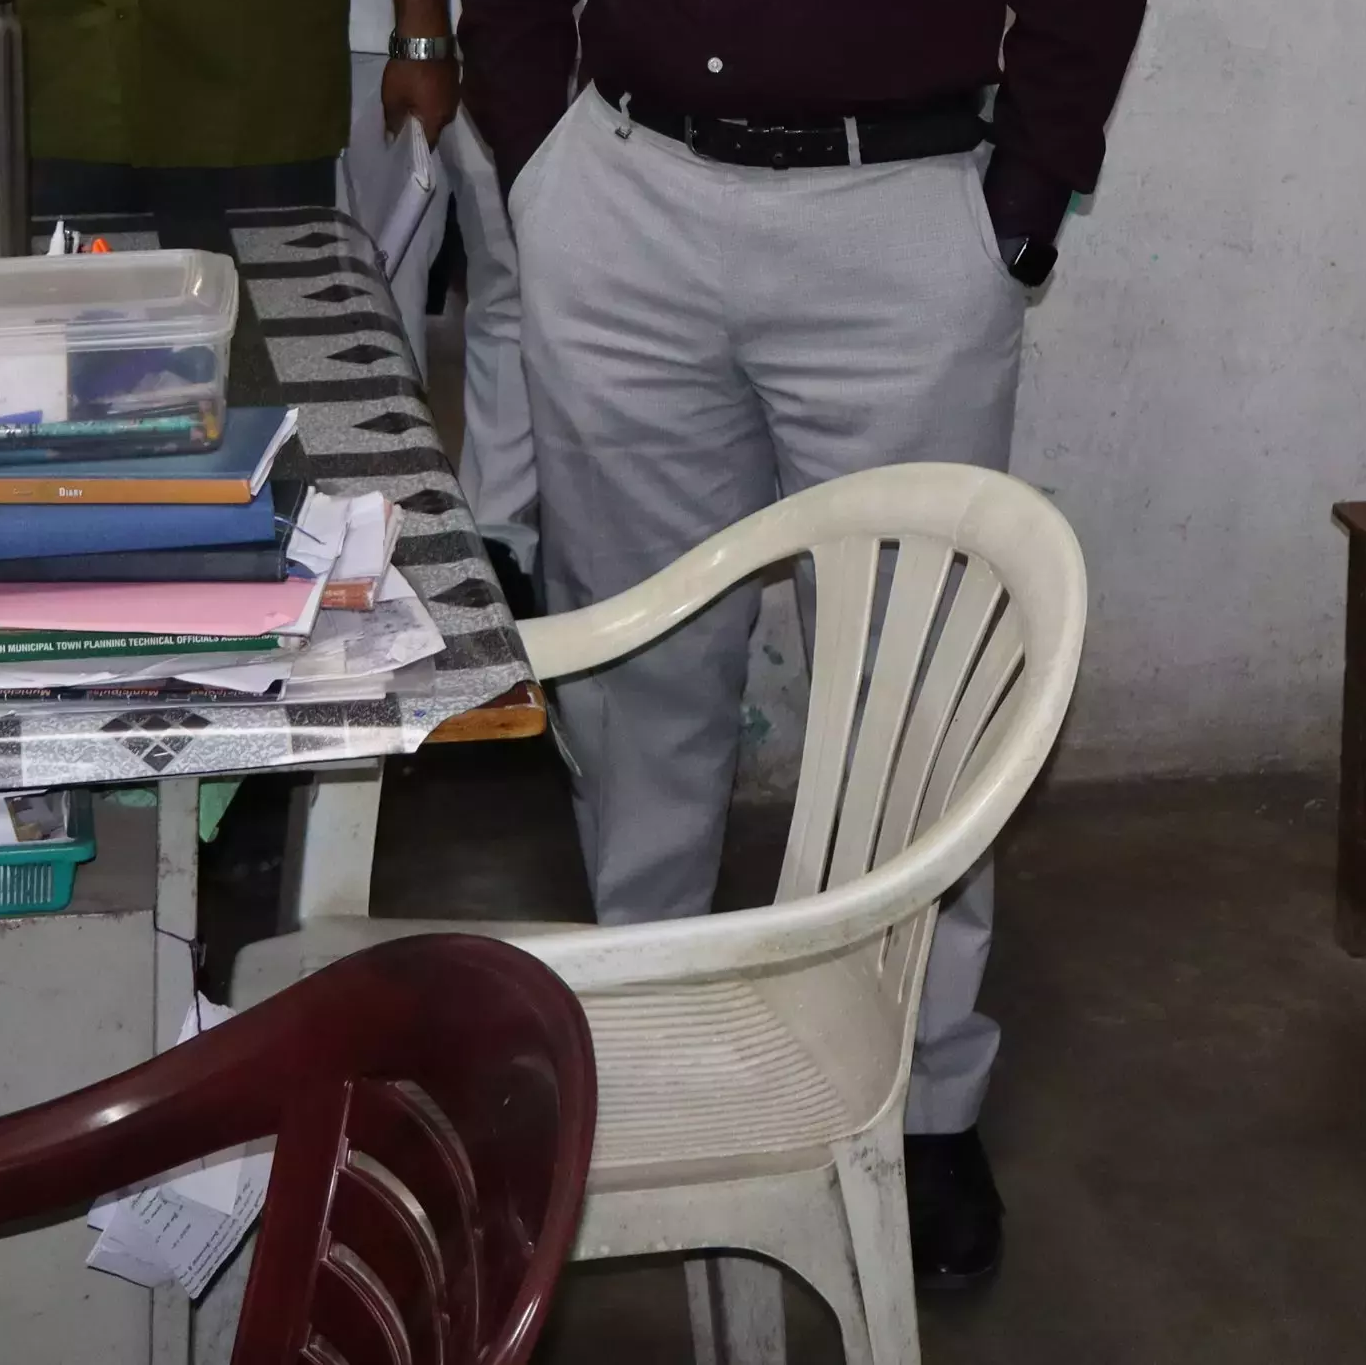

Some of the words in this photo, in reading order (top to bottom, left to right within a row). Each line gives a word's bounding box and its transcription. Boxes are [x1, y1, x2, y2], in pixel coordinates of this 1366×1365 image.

[8, 641, 54, 653] MUNICIPAL
[56, 640, 81, 652] TOWN
[83, 638, 127, 650] PLANNING
[129, 636, 175, 648] TECHNICAL
[177, 635, 219, 646] OFFICIALS
